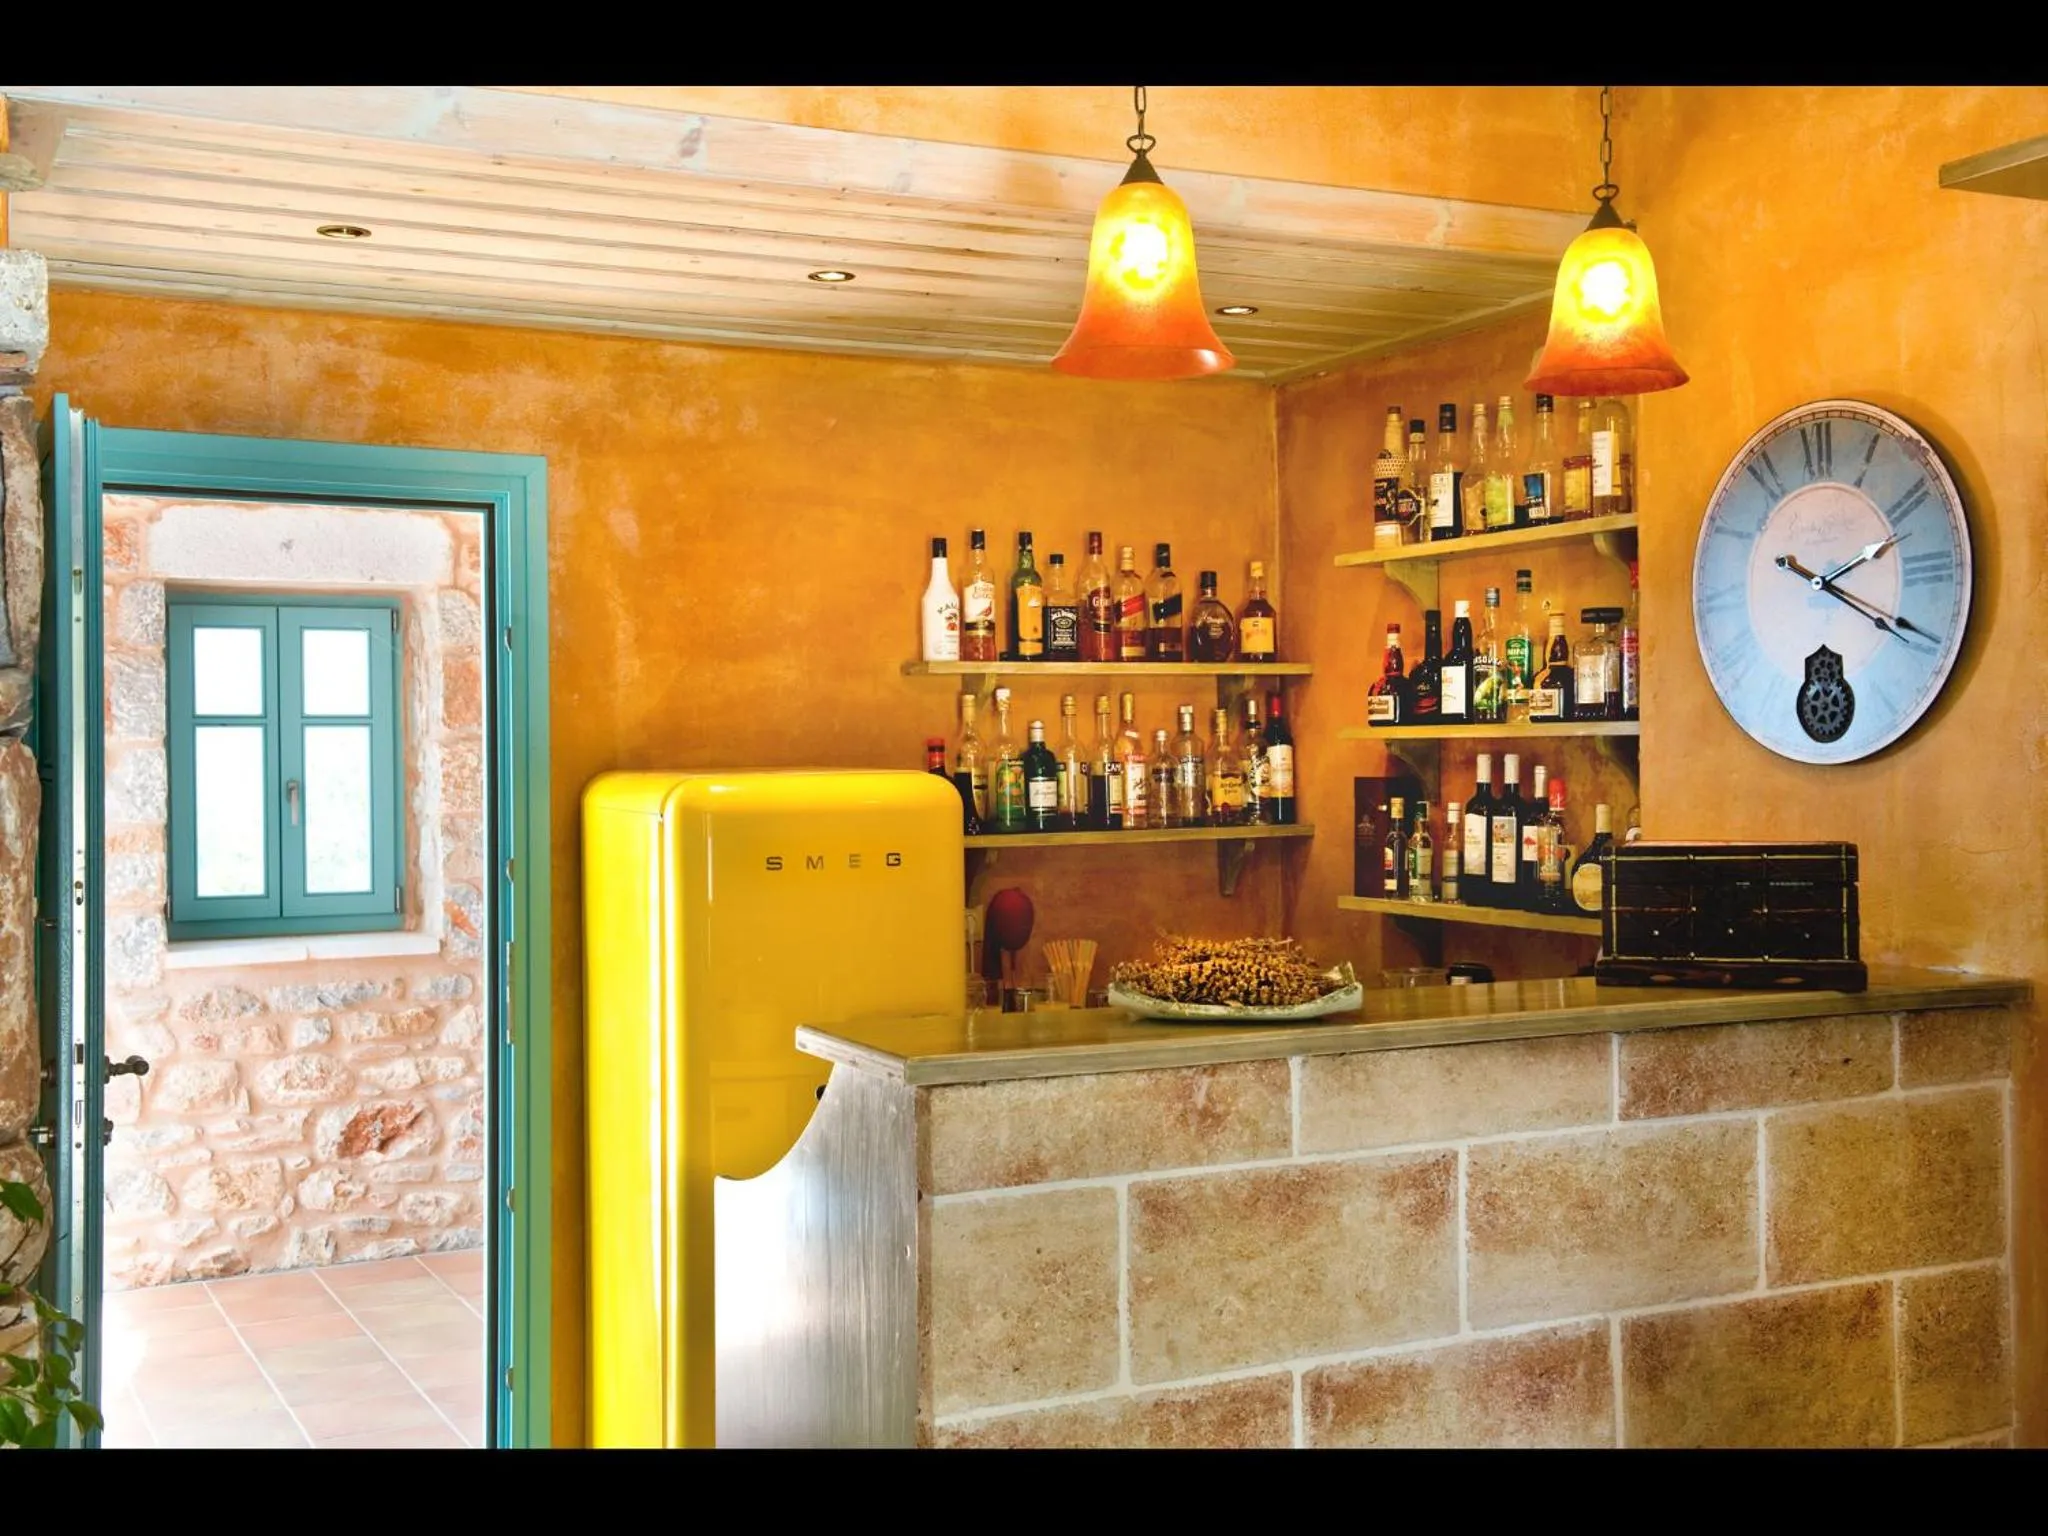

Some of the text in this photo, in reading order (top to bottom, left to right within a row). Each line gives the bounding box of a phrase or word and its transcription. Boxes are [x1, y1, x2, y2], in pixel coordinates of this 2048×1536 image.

[1800, 421, 1832, 483] XII
[1885, 476, 1931, 527] II
[1903, 551, 1954, 588] III
[766, 853, 902, 871] SMEG
